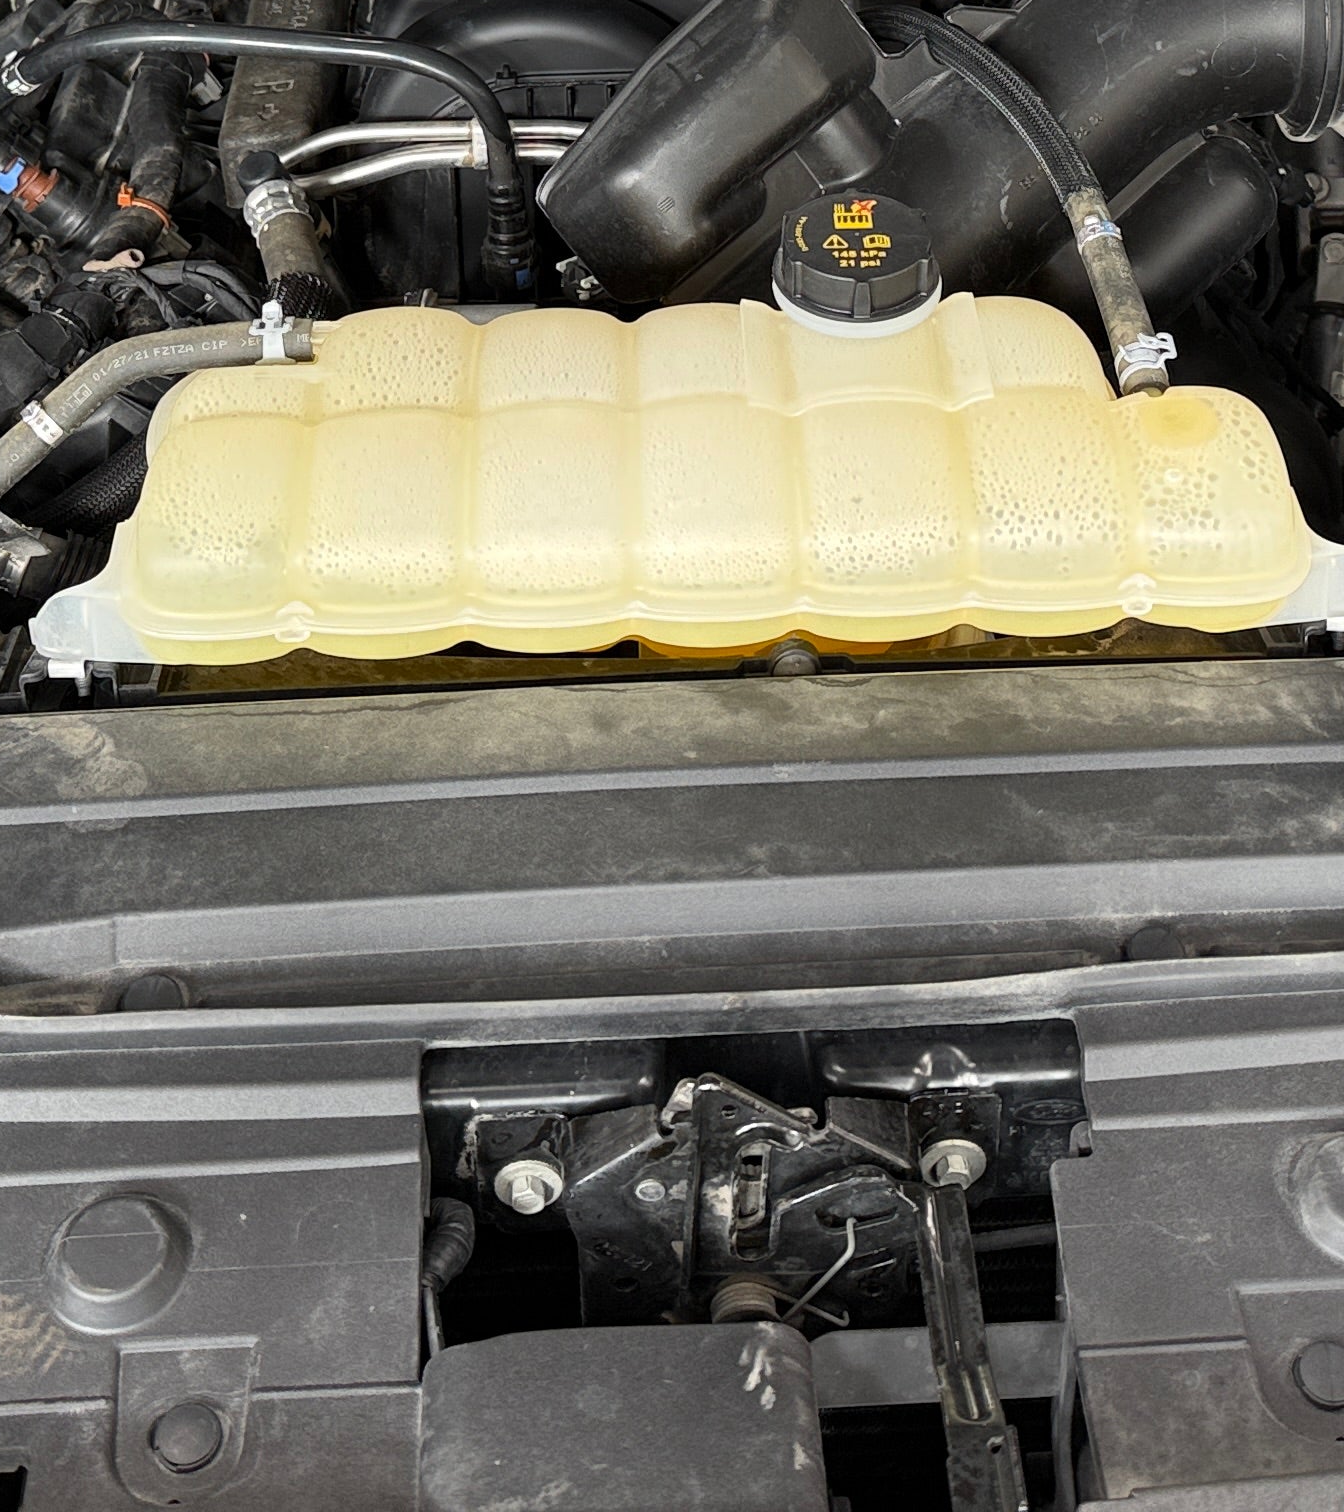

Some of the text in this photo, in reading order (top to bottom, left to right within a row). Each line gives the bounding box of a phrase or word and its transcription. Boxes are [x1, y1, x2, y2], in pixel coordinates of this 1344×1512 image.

[831, 250, 887, 258] 145 kPa
[839, 259, 881, 269] 21 psi
[92, 350, 150, 382] 01/27/21
